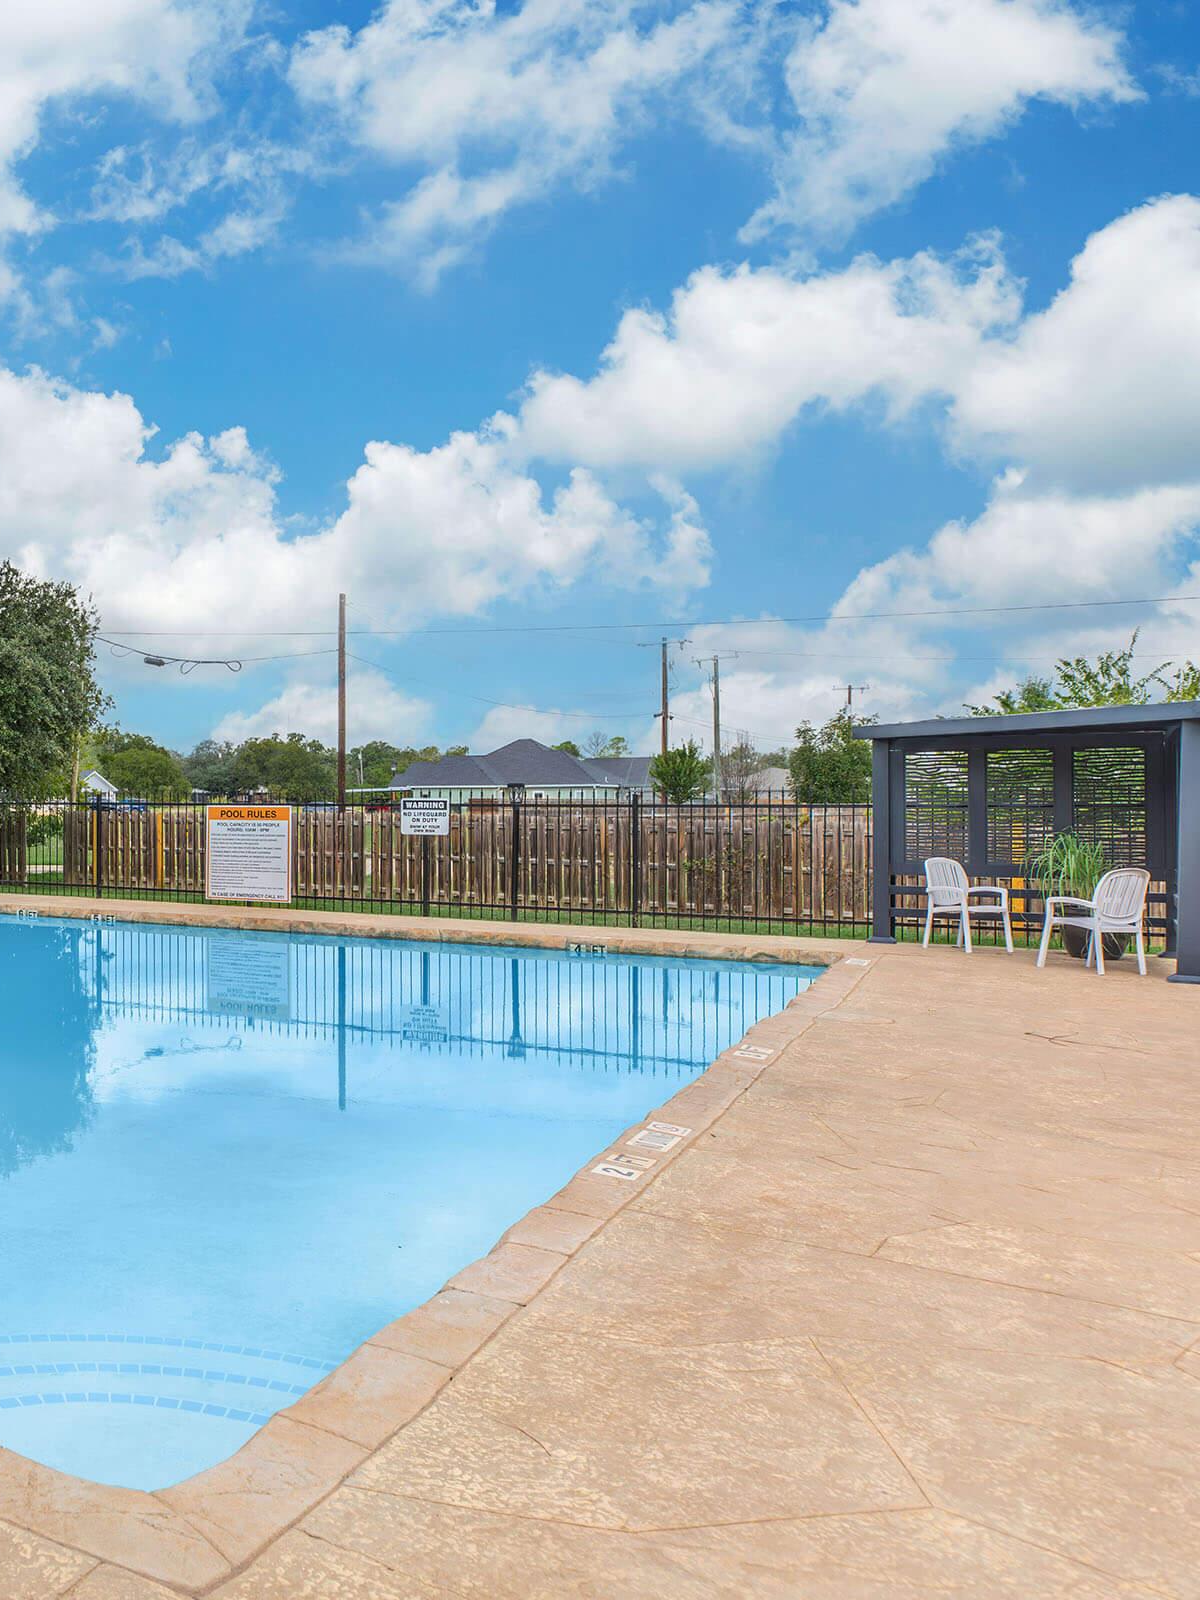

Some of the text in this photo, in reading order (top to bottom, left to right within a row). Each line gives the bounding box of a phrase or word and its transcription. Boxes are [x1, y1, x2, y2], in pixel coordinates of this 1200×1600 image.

[247, 810, 277, 818] RULES
[602, 1154, 649, 1177] 2 FT
